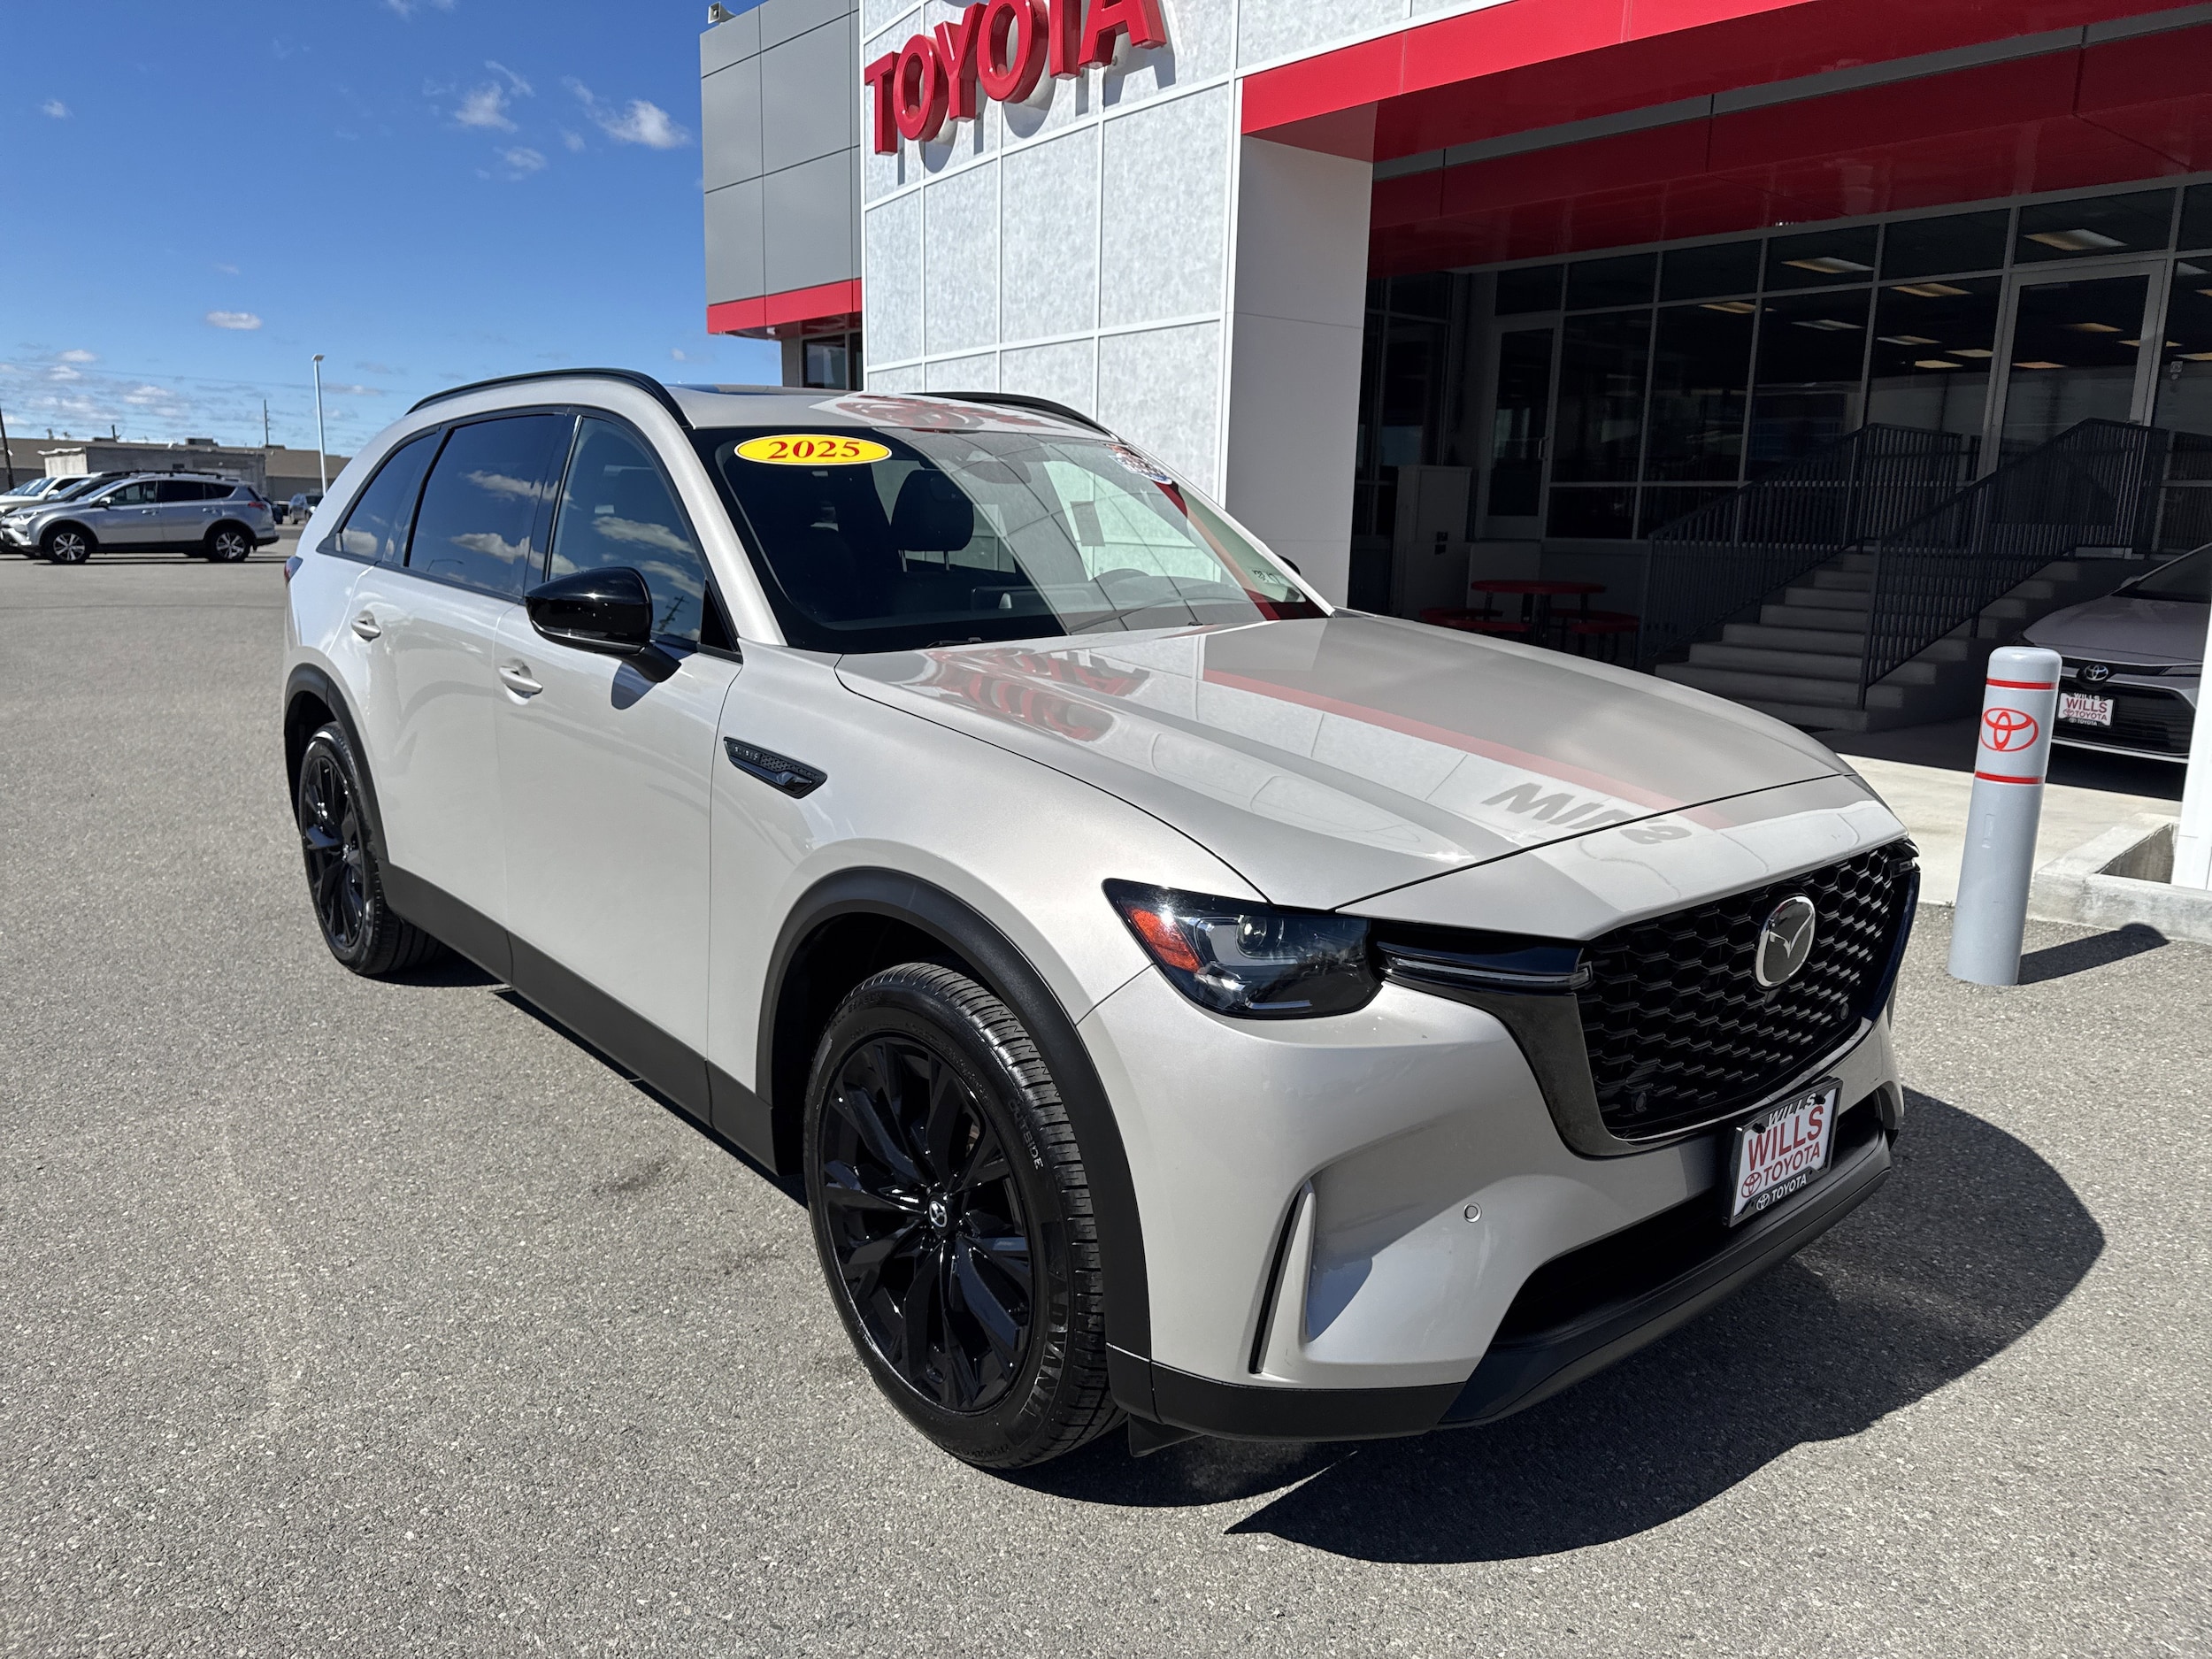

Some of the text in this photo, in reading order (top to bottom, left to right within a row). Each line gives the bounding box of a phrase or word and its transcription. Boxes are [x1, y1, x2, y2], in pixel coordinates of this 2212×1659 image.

[767, 441, 860, 459] 2025
[2066, 697, 2108, 714] WILLS
[2075, 710, 2108, 721] TOYOTA
[1768, 1093, 1817, 1126] WILLS
[1008, 1100, 1045, 1171] OUTSIDE
[1748, 1105, 1824, 1171] WILLS
[1763, 1141, 1821, 1187] TOYOTA
[1771, 1173, 1808, 1203] TOYOTA
